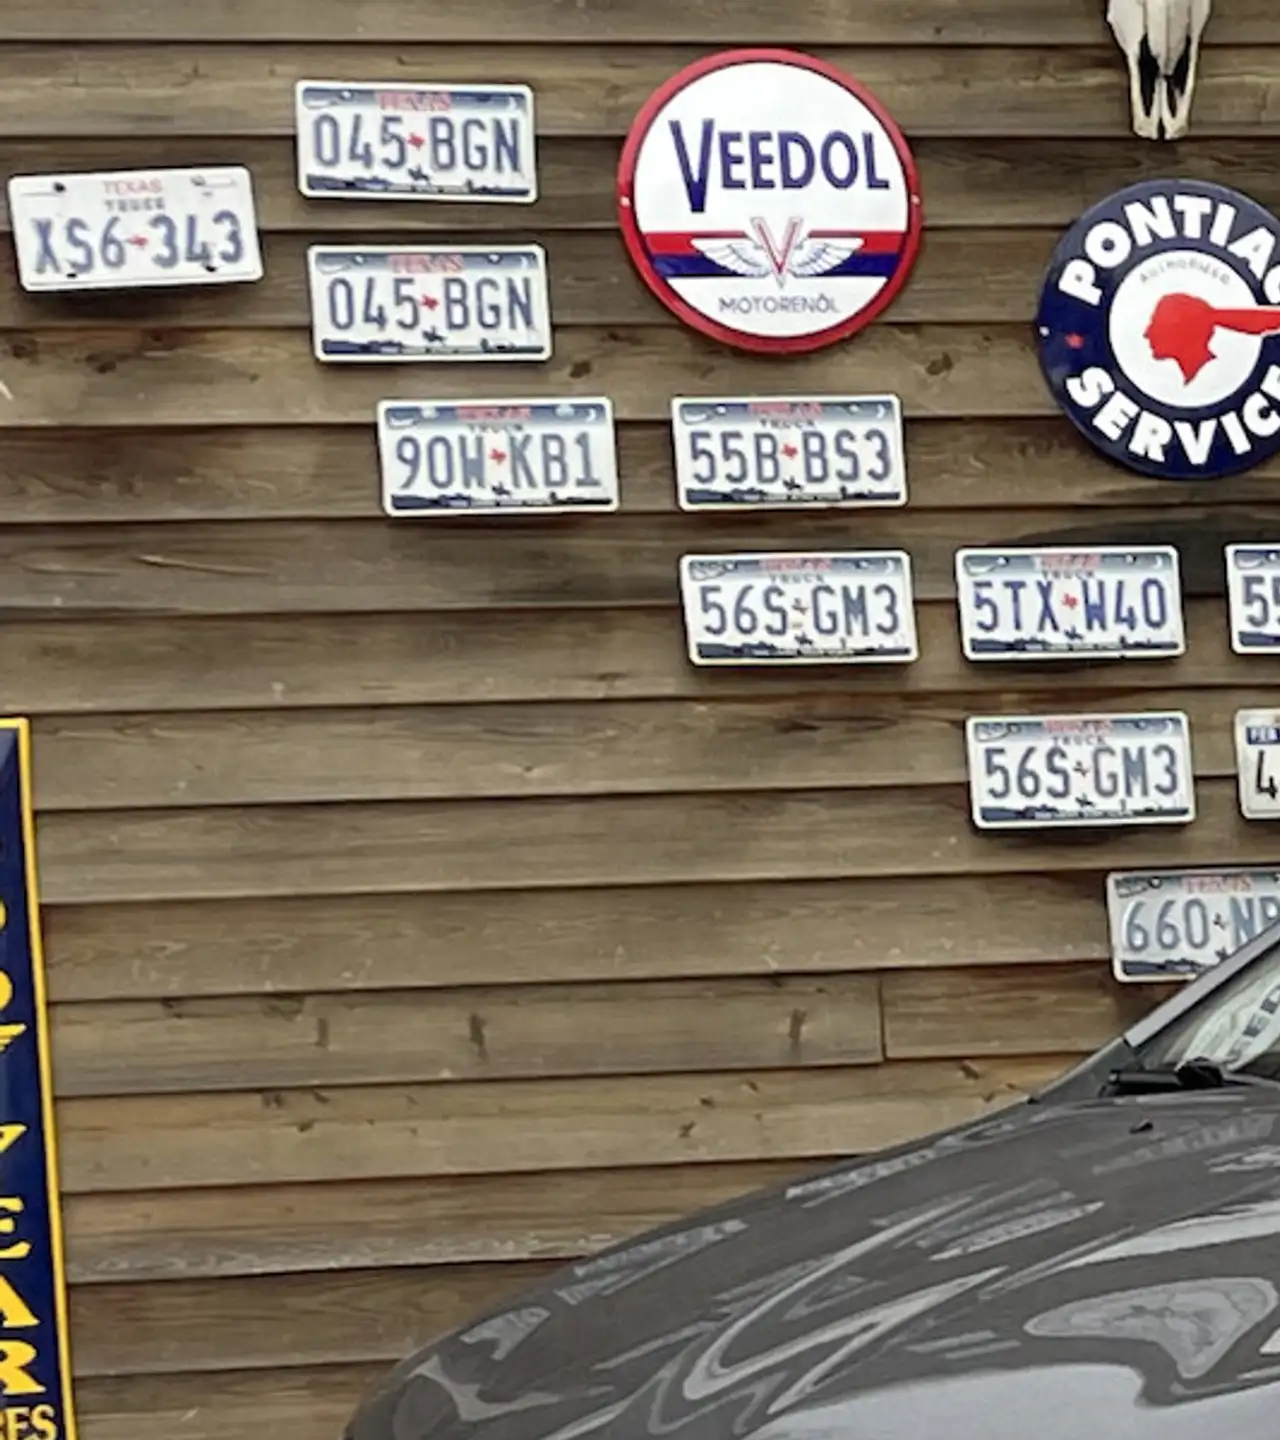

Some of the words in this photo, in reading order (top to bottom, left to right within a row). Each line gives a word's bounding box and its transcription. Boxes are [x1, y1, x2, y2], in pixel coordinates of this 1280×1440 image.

[668, 118, 890, 213] VEEDOL
[102, 178, 164, 195] TEXAS
[718, 292, 840, 314] MOTORENÖL
